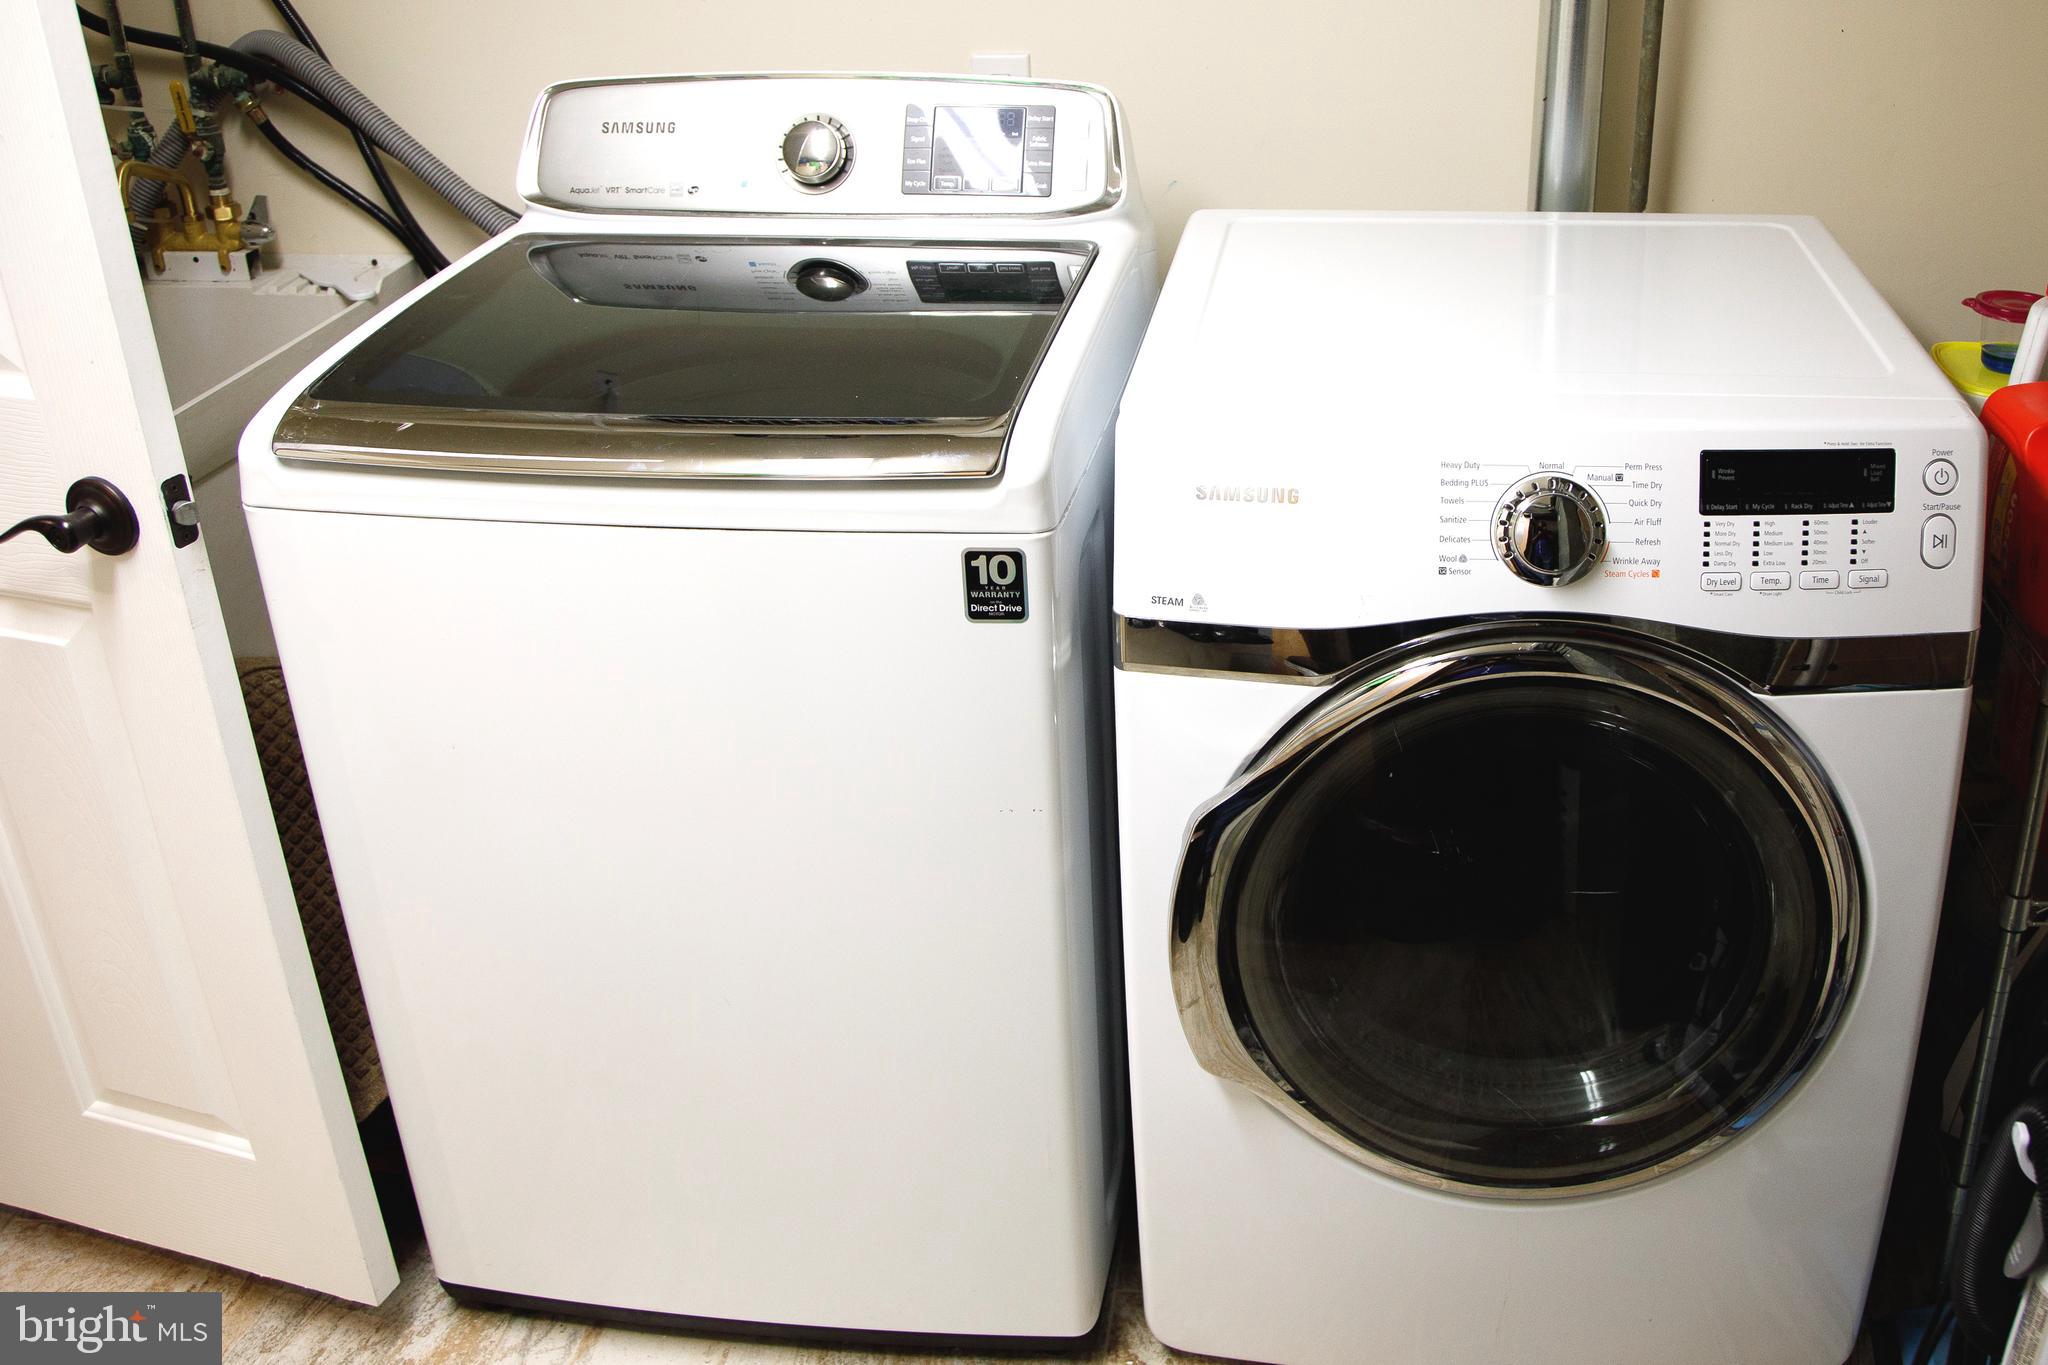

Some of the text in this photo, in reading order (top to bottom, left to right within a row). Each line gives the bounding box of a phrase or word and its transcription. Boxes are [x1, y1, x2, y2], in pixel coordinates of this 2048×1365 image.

[601, 122, 676, 134] SAMSUNG
[625, 186, 665, 194] SmartCare
[1440, 461, 1480, 470] Heavy Duty
[1538, 461, 1565, 470] Normal
[1624, 463, 1663, 471] Perm Press
[1587, 473, 1614, 481] Manual
[1440, 478, 1489, 488] Bedding PLUS
[1632, 481, 1663, 491] Time Dry
[1195, 486, 1300, 504] SAMSUNG
[1440, 496, 1465, 504] Towels
[1628, 499, 1663, 509] Quick Dry
[1752, 502, 1775, 511] My Cycle
[1922, 503, 1961, 511] Start/Pause
[1439, 515, 1468, 524] Sanitize
[1646, 518, 1662, 526] Fluff
[1439, 535, 1471, 543] Delicates
[1635, 538, 1661, 546] Refresh
[1438, 554, 1458, 563] Wool
[1612, 557, 1661, 567] Wrinkle Away
[970, 554, 1016, 585] 10
[1448, 567, 1472, 575] Sensor
[1604, 570, 1650, 579] Steam Cycles
[1706, 578, 1737, 587] Dry Level
[1760, 577, 1782, 587] Temp.
[1812, 576, 1830, 584] Time
[1859, 575, 1880, 585] Signal
[970, 591, 1021, 599] WARRANTY
[1151, 596, 1184, 607] STEAM
[970, 604, 1022, 612] Direct Drive
